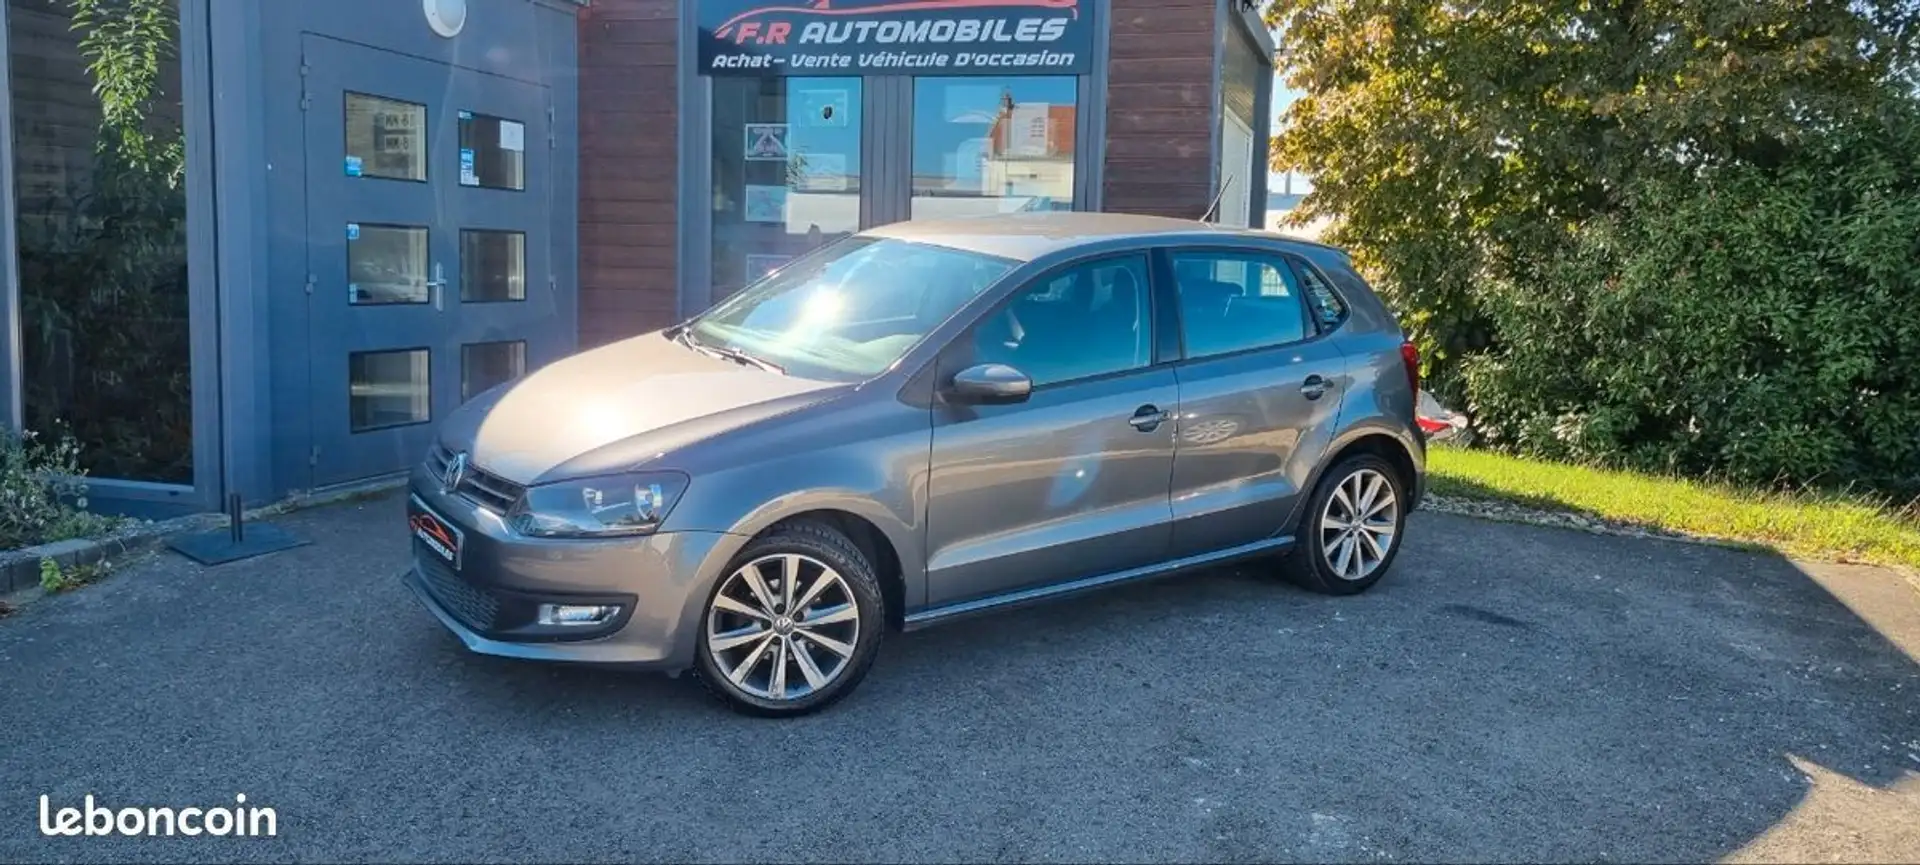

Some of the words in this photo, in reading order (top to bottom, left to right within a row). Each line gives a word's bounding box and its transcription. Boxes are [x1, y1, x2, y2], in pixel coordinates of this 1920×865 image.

[735, 22, 791, 45] F.R
[799, 18, 1067, 44] AUTOMOBILES
[790, 53, 851, 68] Vente
[859, 50, 948, 67] Véhicule
[954, 50, 1075, 67] D'occasion
